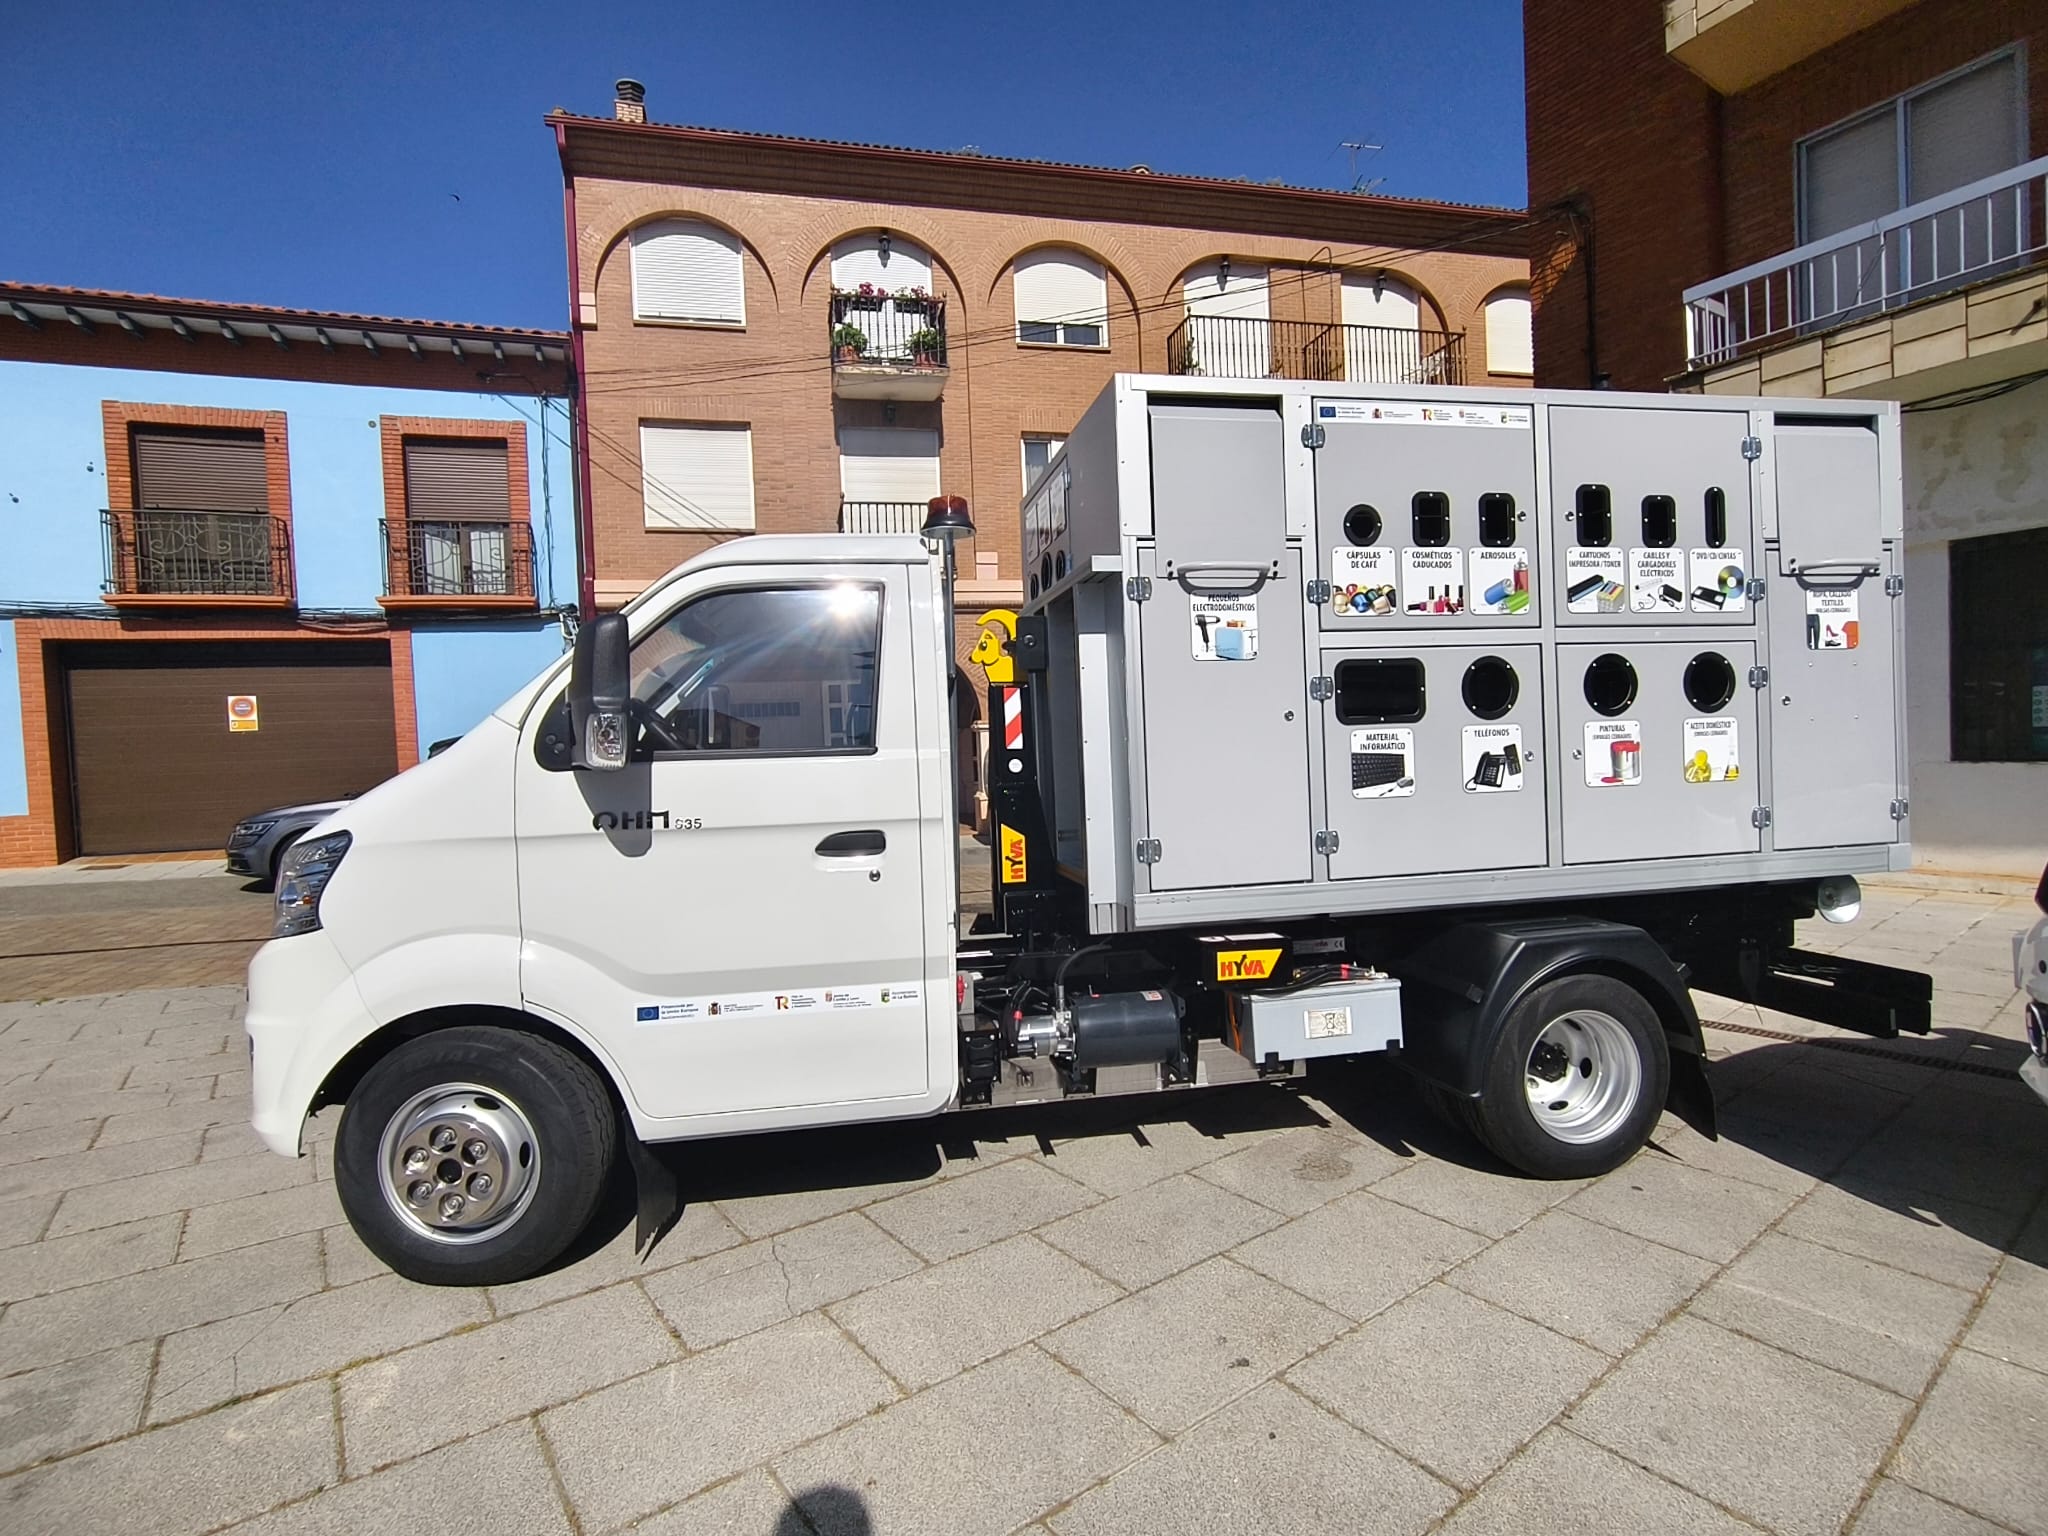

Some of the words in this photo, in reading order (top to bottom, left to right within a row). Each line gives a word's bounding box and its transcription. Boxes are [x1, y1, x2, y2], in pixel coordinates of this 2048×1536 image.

[1346, 550, 1381, 559] CÁPSULAS
[1412, 551, 1453, 560] COSMÉTICOS
[1480, 551, 1516, 560] AEROSOLES
[1579, 551, 1611, 559] CARTUCHOS
[1361, 560, 1377, 568] CAFÉ
[1412, 561, 1452, 569] CADUCADOS
[1637, 560, 1676, 569] CARGADORES
[1640, 569, 1674, 577] ELÉCTRICOS
[1208, 592, 1239, 601] PEQUEÑOS
[1192, 602, 1255, 611] ELECTRODOMÉSTICOS
[1599, 724, 1626, 732] PINTURAS
[1366, 733, 1399, 741] MATERIAL
[1474, 728, 1510, 738] TELÉFONOS
[1360, 742, 1406, 751] INFORMÁTICO
[1005, 838, 1024, 880] HYVA
[1220, 954, 1265, 977] HYVA
